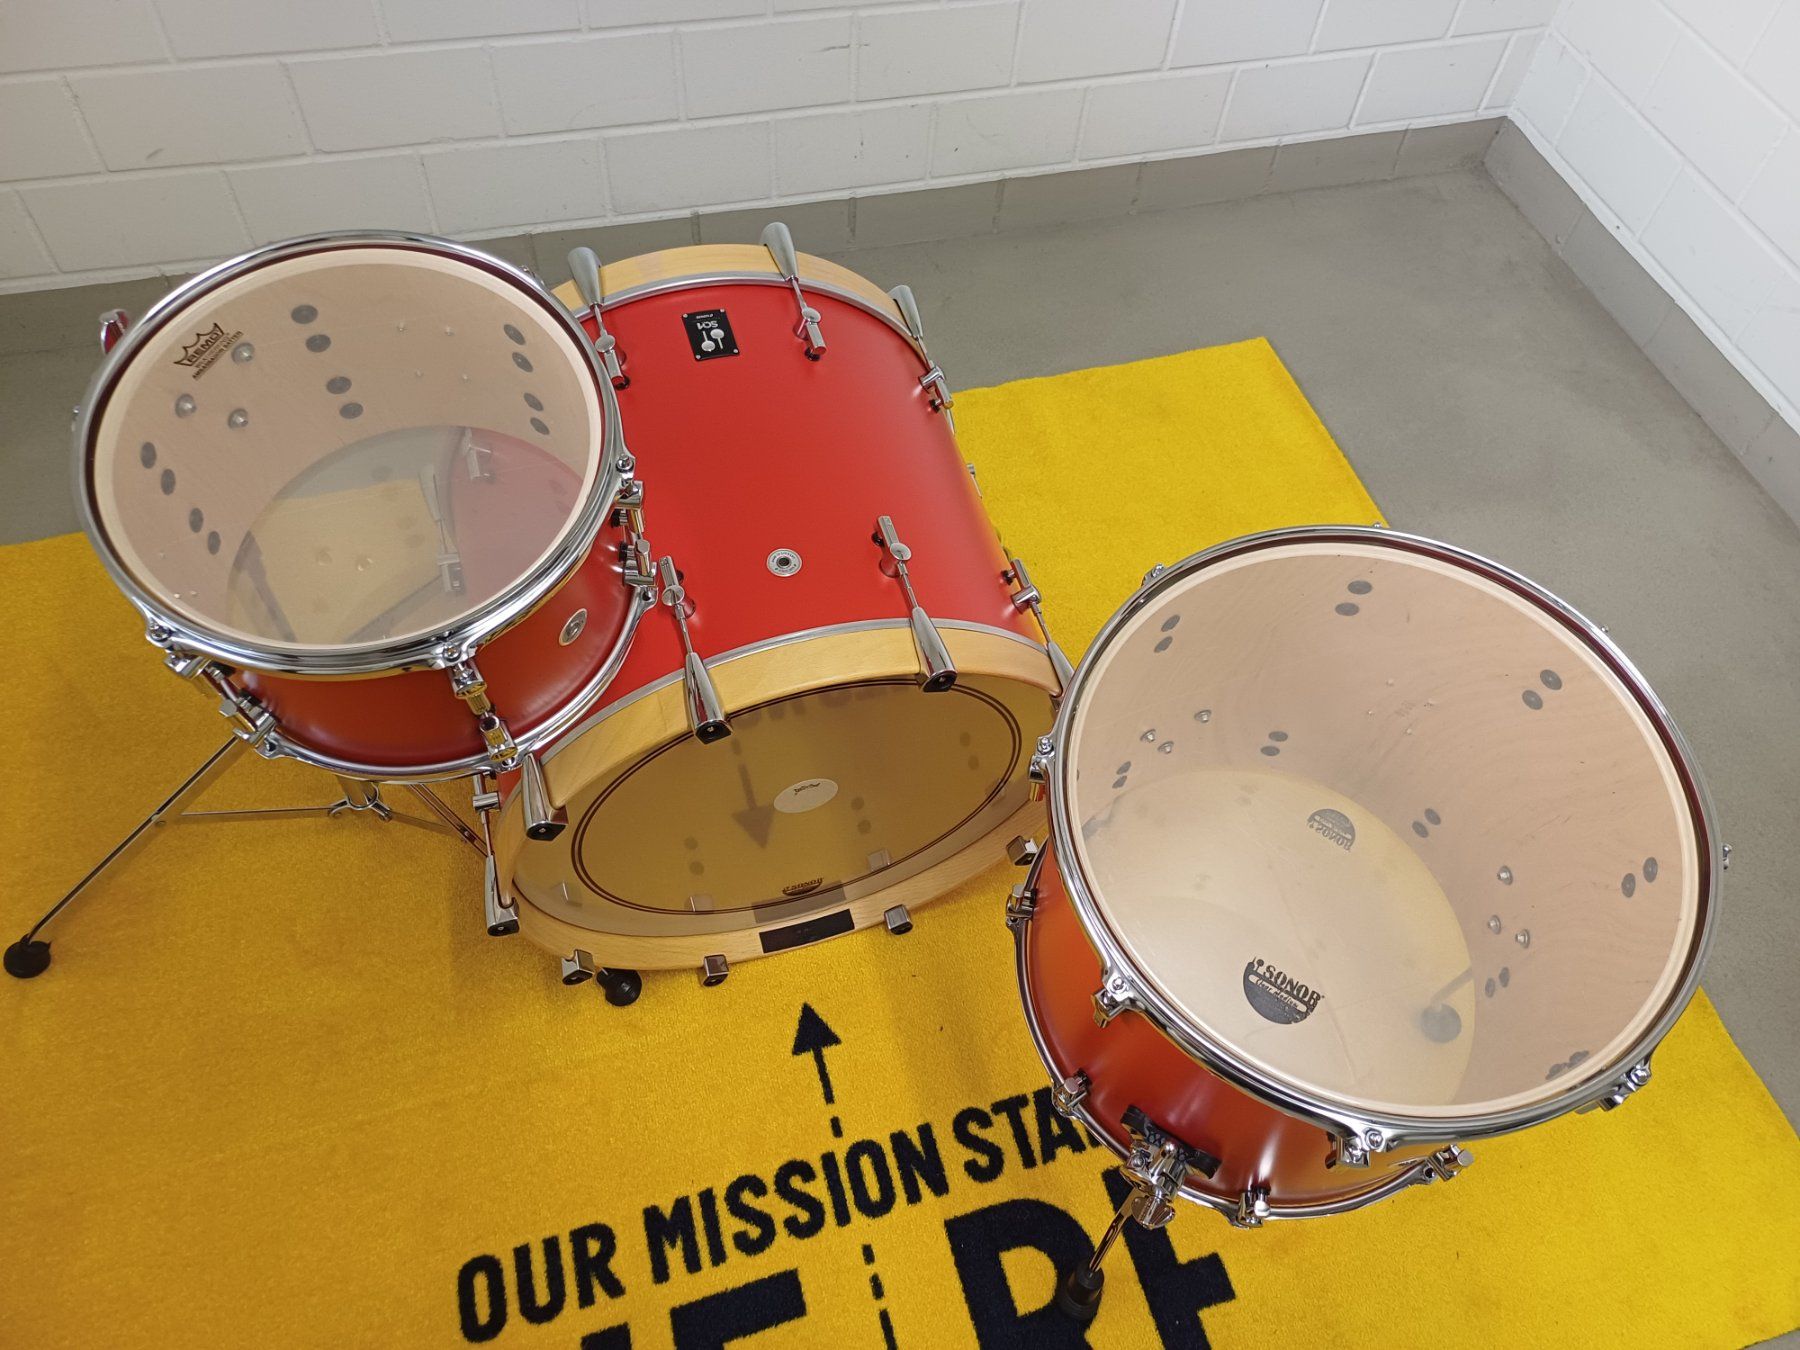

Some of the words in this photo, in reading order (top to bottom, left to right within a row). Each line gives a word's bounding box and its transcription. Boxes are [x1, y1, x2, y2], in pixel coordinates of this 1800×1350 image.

[187, 332, 220, 362] REMO
[1263, 965, 1320, 1004] SONOR
[457, 1222, 626, 1343] OUR
[643, 1123, 949, 1285] MISSION
[953, 1086, 1102, 1184] STA
